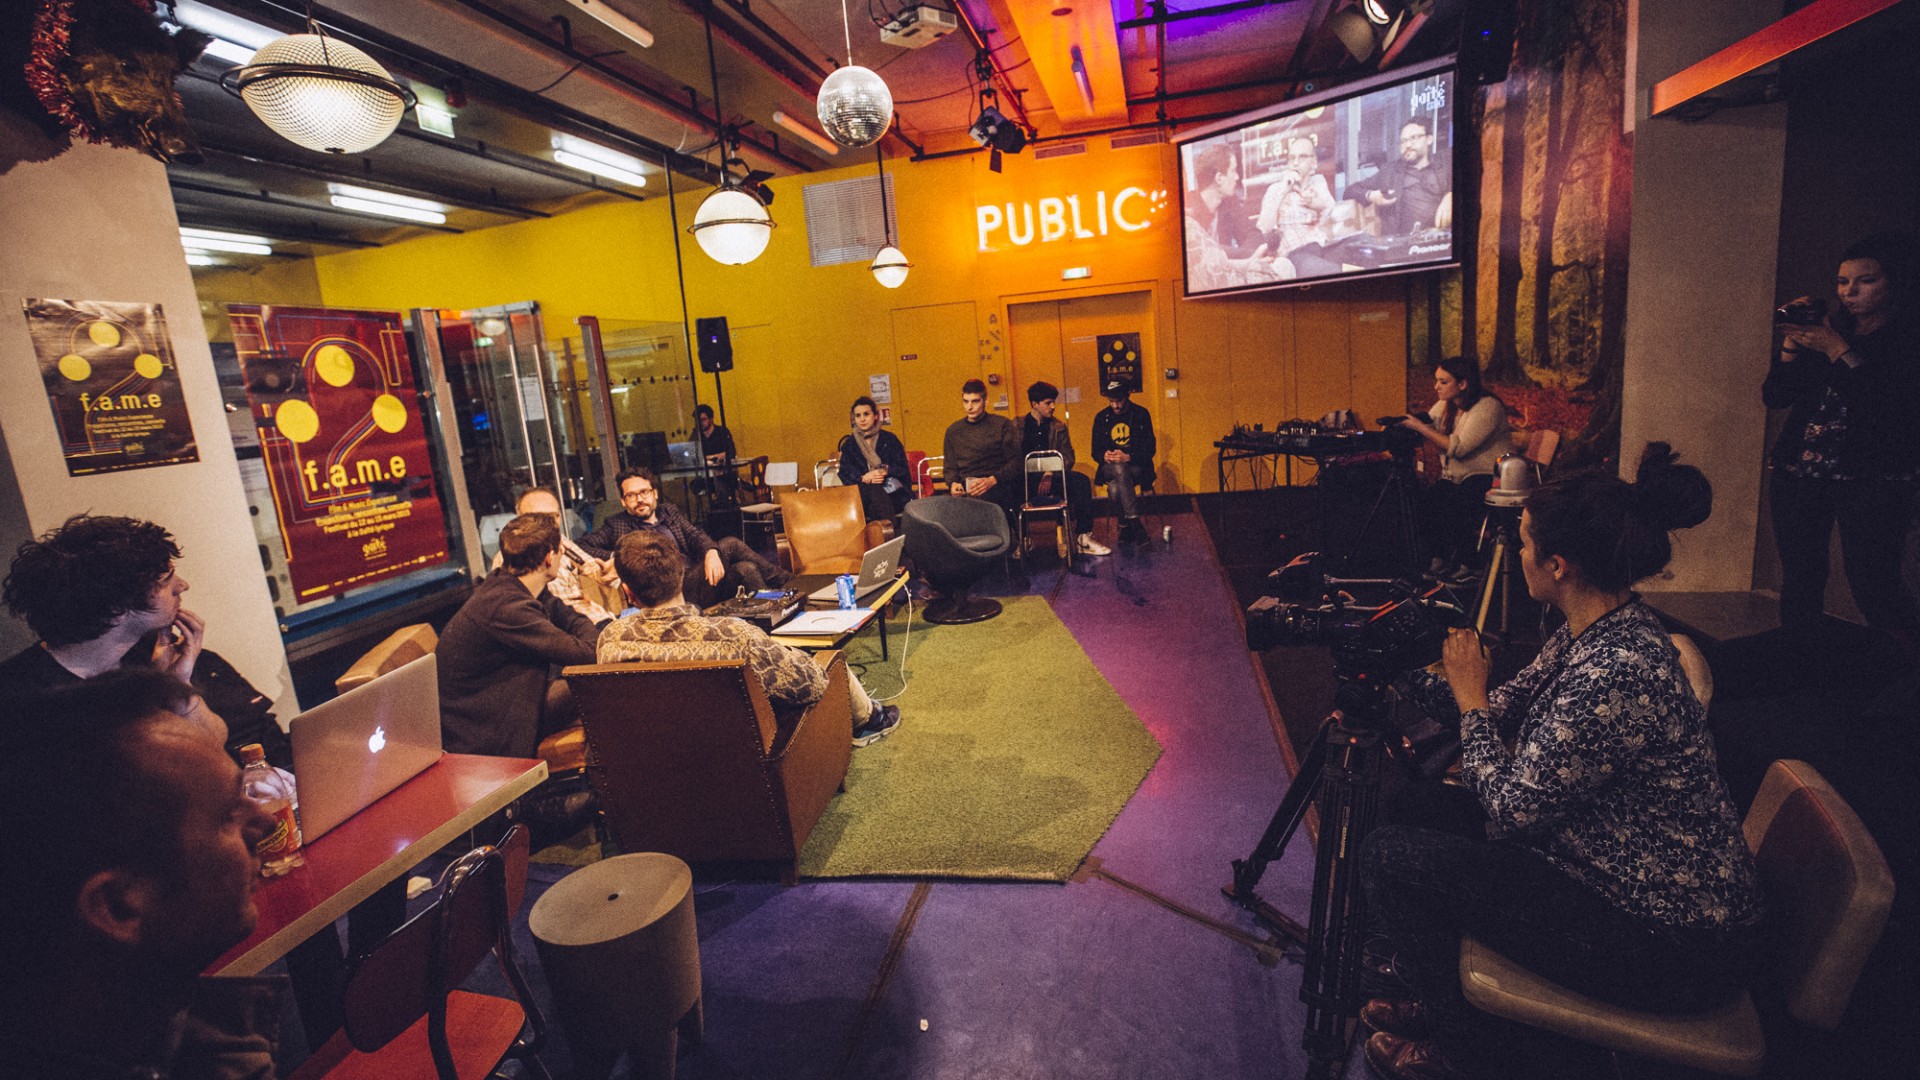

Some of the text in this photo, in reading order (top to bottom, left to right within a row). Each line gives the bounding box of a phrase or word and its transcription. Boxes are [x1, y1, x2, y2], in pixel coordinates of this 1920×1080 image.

[977, 187, 1150, 252] PUBLIC
[79, 392, 162, 411] f.a.m.e
[304, 455, 406, 492] f.a.m.e
